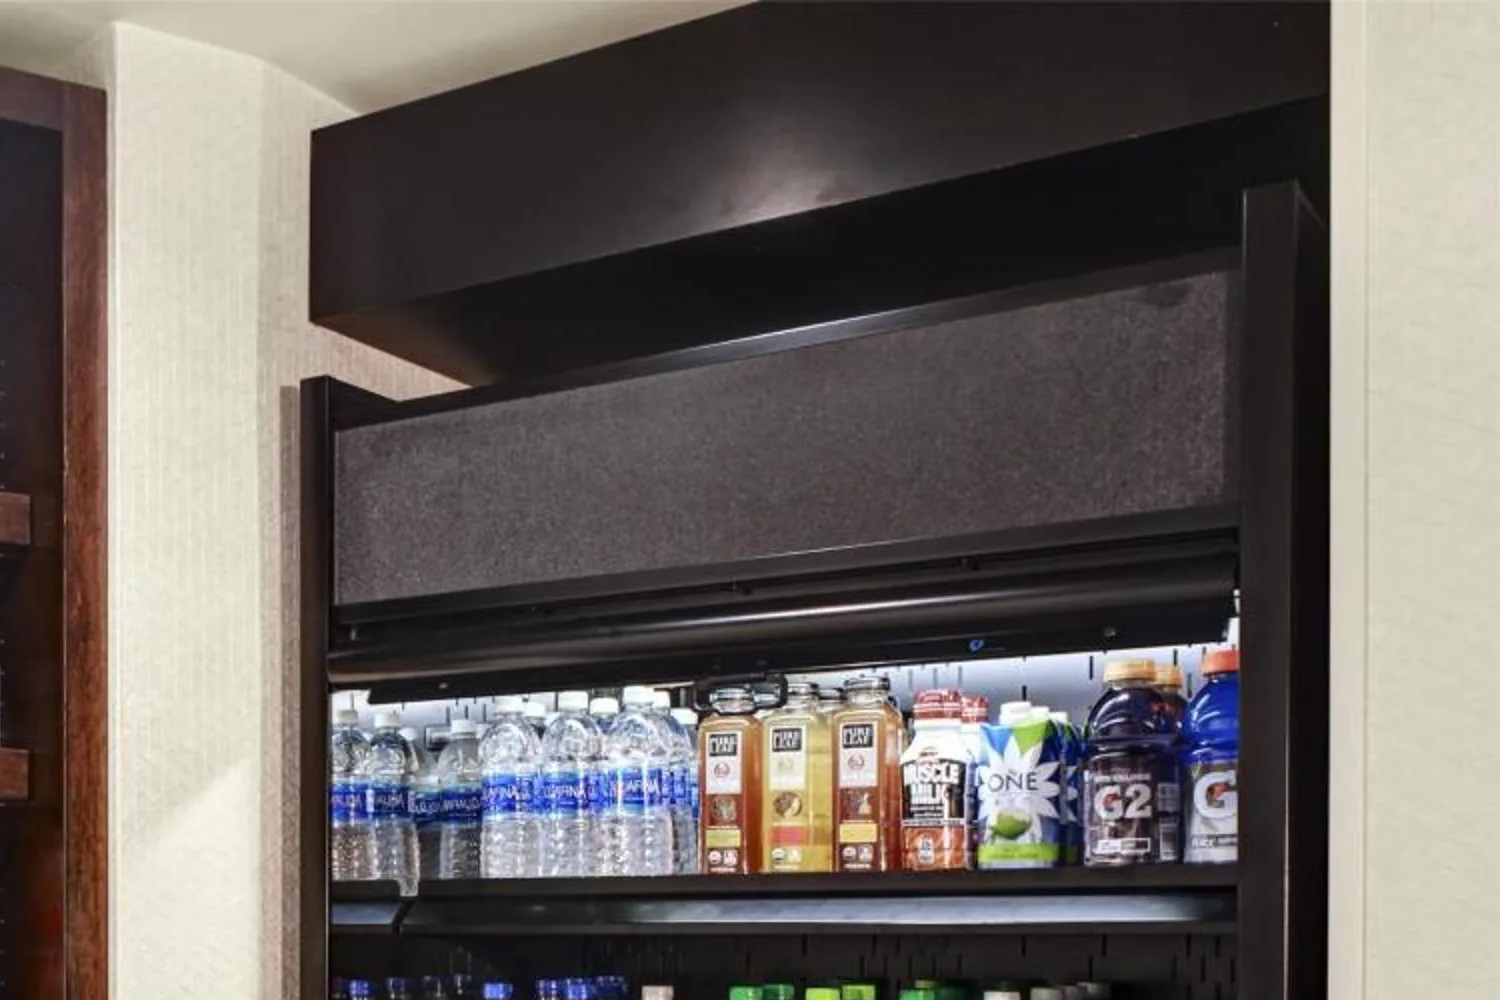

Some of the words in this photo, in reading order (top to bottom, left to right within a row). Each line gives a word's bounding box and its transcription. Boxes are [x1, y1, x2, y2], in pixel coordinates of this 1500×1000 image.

[773, 728, 802, 740] PURE
[843, 726, 872, 737] PURE
[709, 734, 738, 746] PURE
[773, 739, 801, 751] LEAF
[842, 735, 871, 747] LEAF
[709, 745, 737, 756] LEAF
[987, 771, 1040, 792] ONE
[1193, 770, 1238, 819] G
[1094, 783, 1153, 820] G2
